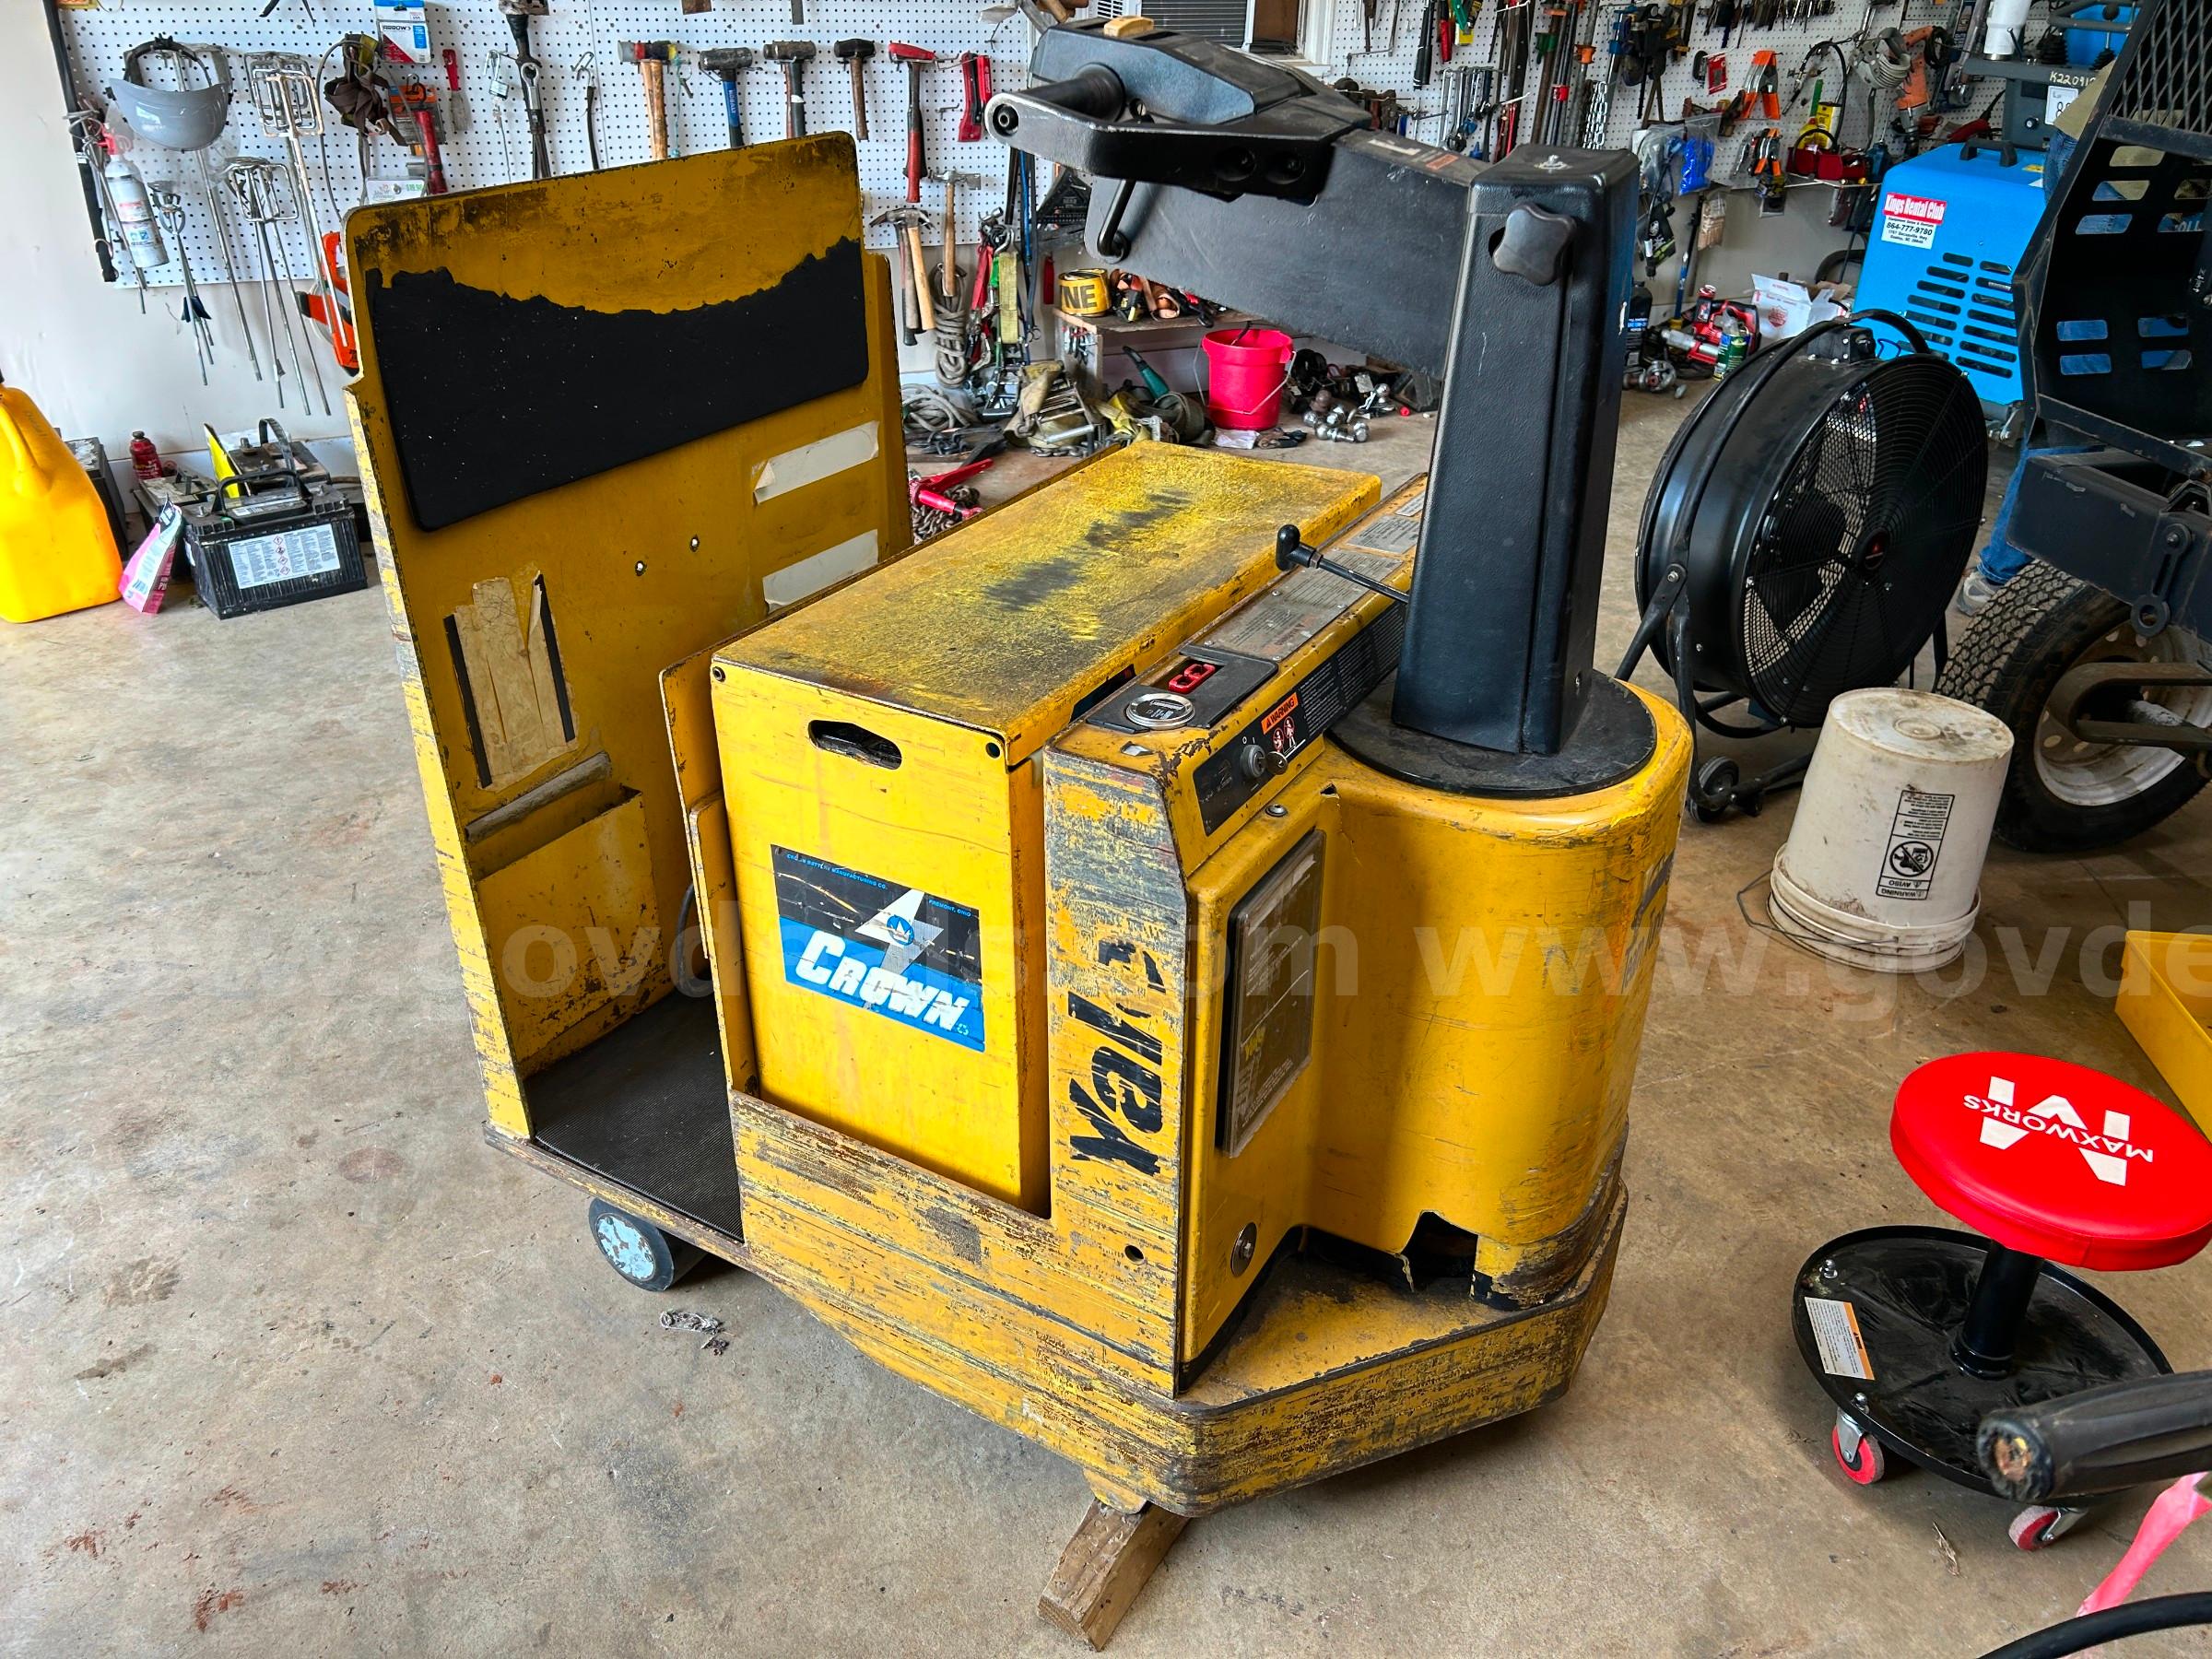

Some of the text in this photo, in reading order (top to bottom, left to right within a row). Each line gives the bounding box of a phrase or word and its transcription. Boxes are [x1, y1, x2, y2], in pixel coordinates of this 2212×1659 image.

[728, 89, 736, 113] KOBALT
[1884, 194, 1946, 221] Kings Rental Club
[1886, 221, 1933, 236] 864-777-9780
[1269, 698, 1295, 724] WARNING
[1881, 888, 1916, 898] WARNING
[1888, 879, 1912, 888] AVISO
[795, 930, 971, 1031] CROWN
[1963, 1093, 2154, 1163] MAXWORKS
